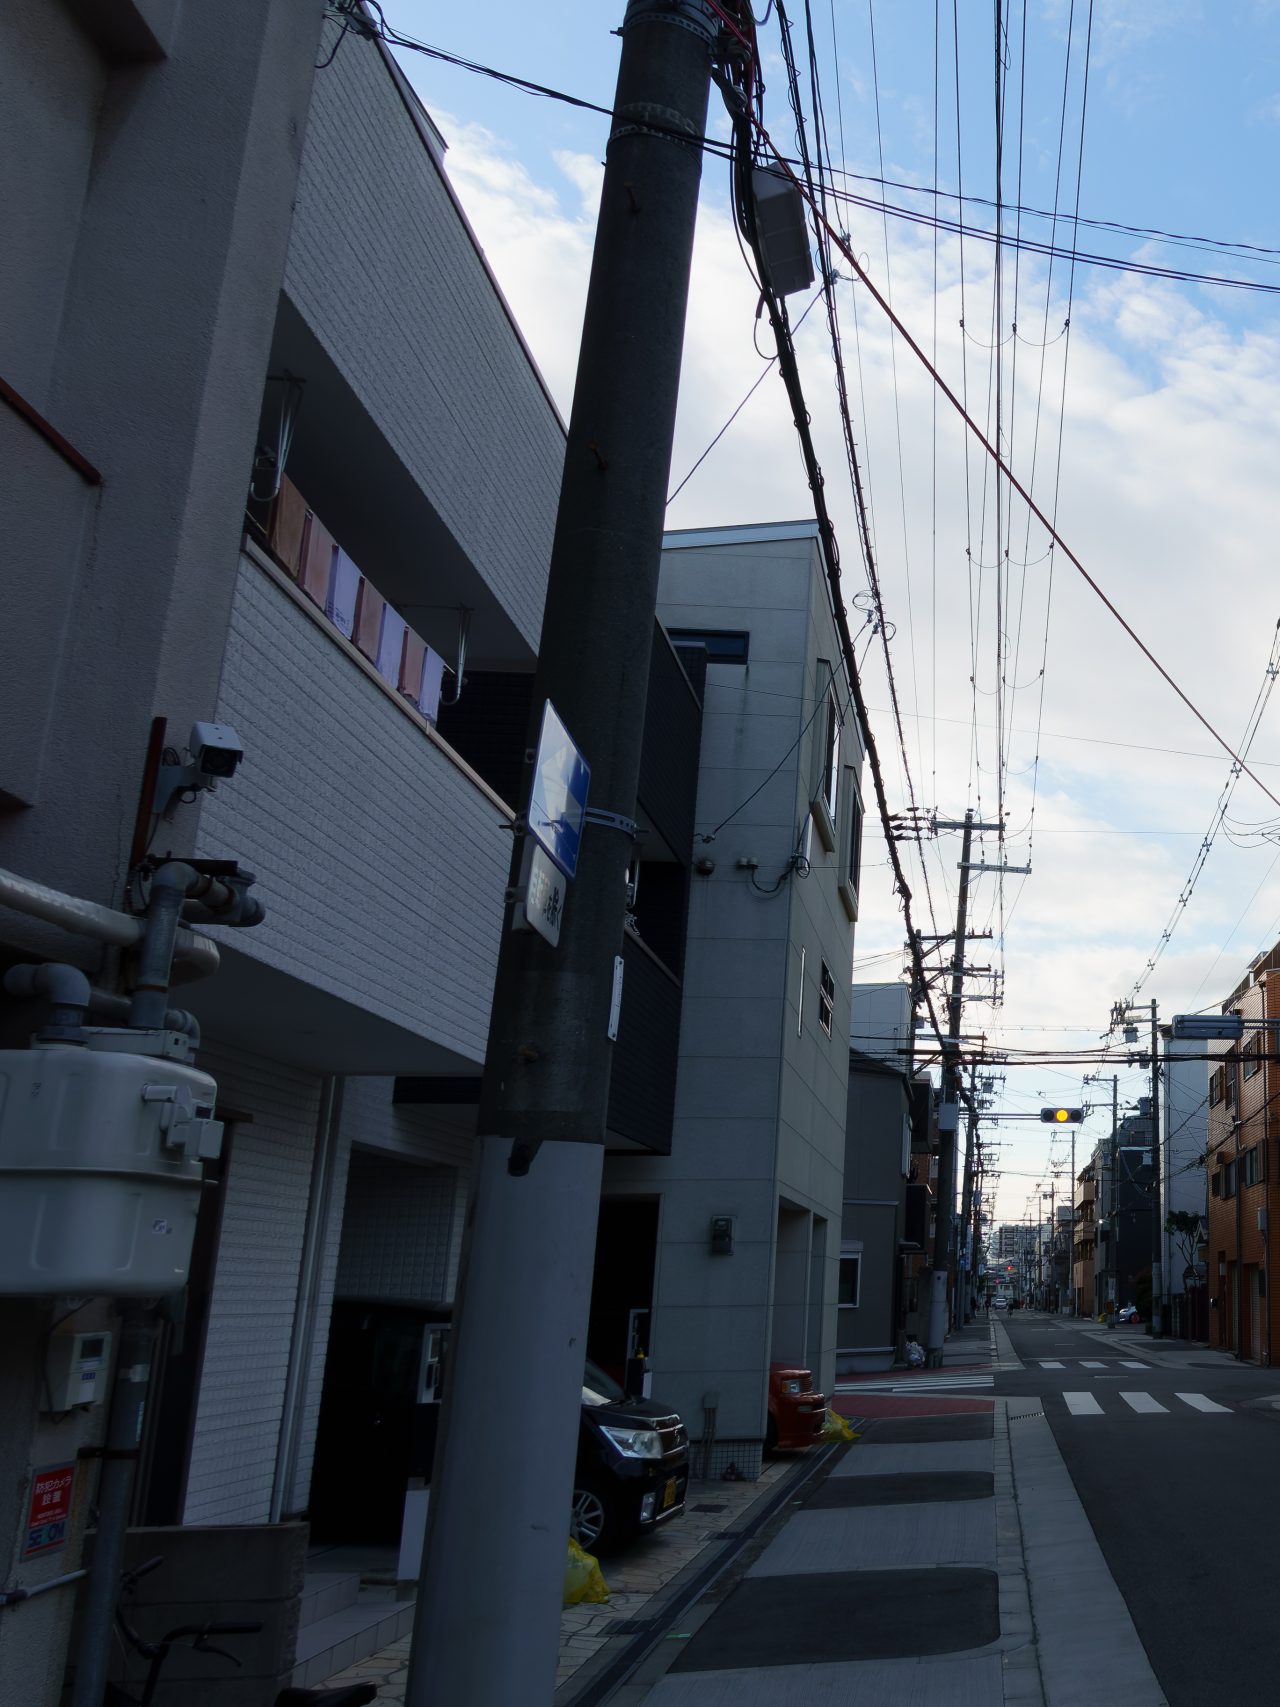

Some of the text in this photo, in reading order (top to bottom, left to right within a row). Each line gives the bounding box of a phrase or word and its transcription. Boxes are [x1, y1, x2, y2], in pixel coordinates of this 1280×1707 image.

[36, 1475, 72, 1495] 防犯カメラ
[29, 1521, 65, 1547] SECOM
